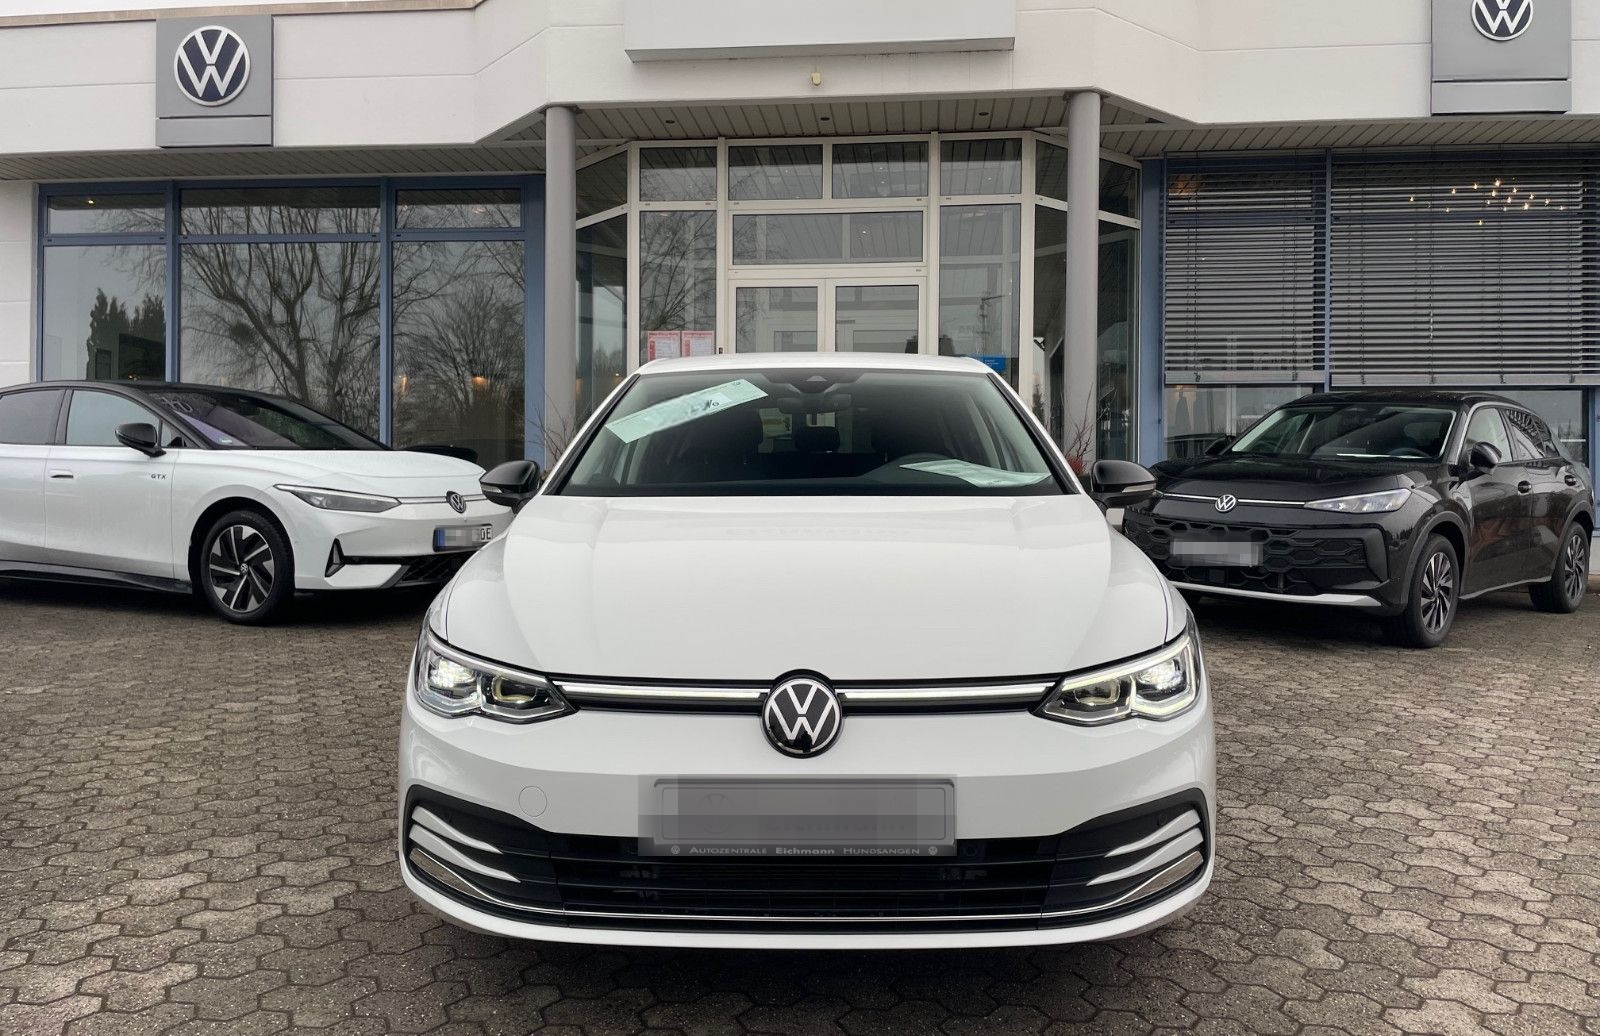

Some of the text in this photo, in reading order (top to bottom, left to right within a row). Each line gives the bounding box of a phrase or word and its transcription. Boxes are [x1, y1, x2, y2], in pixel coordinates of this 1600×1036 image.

[175, 26, 249, 104] VW
[1216, 495, 1236, 511] VW
[765, 679, 839, 752] VW
